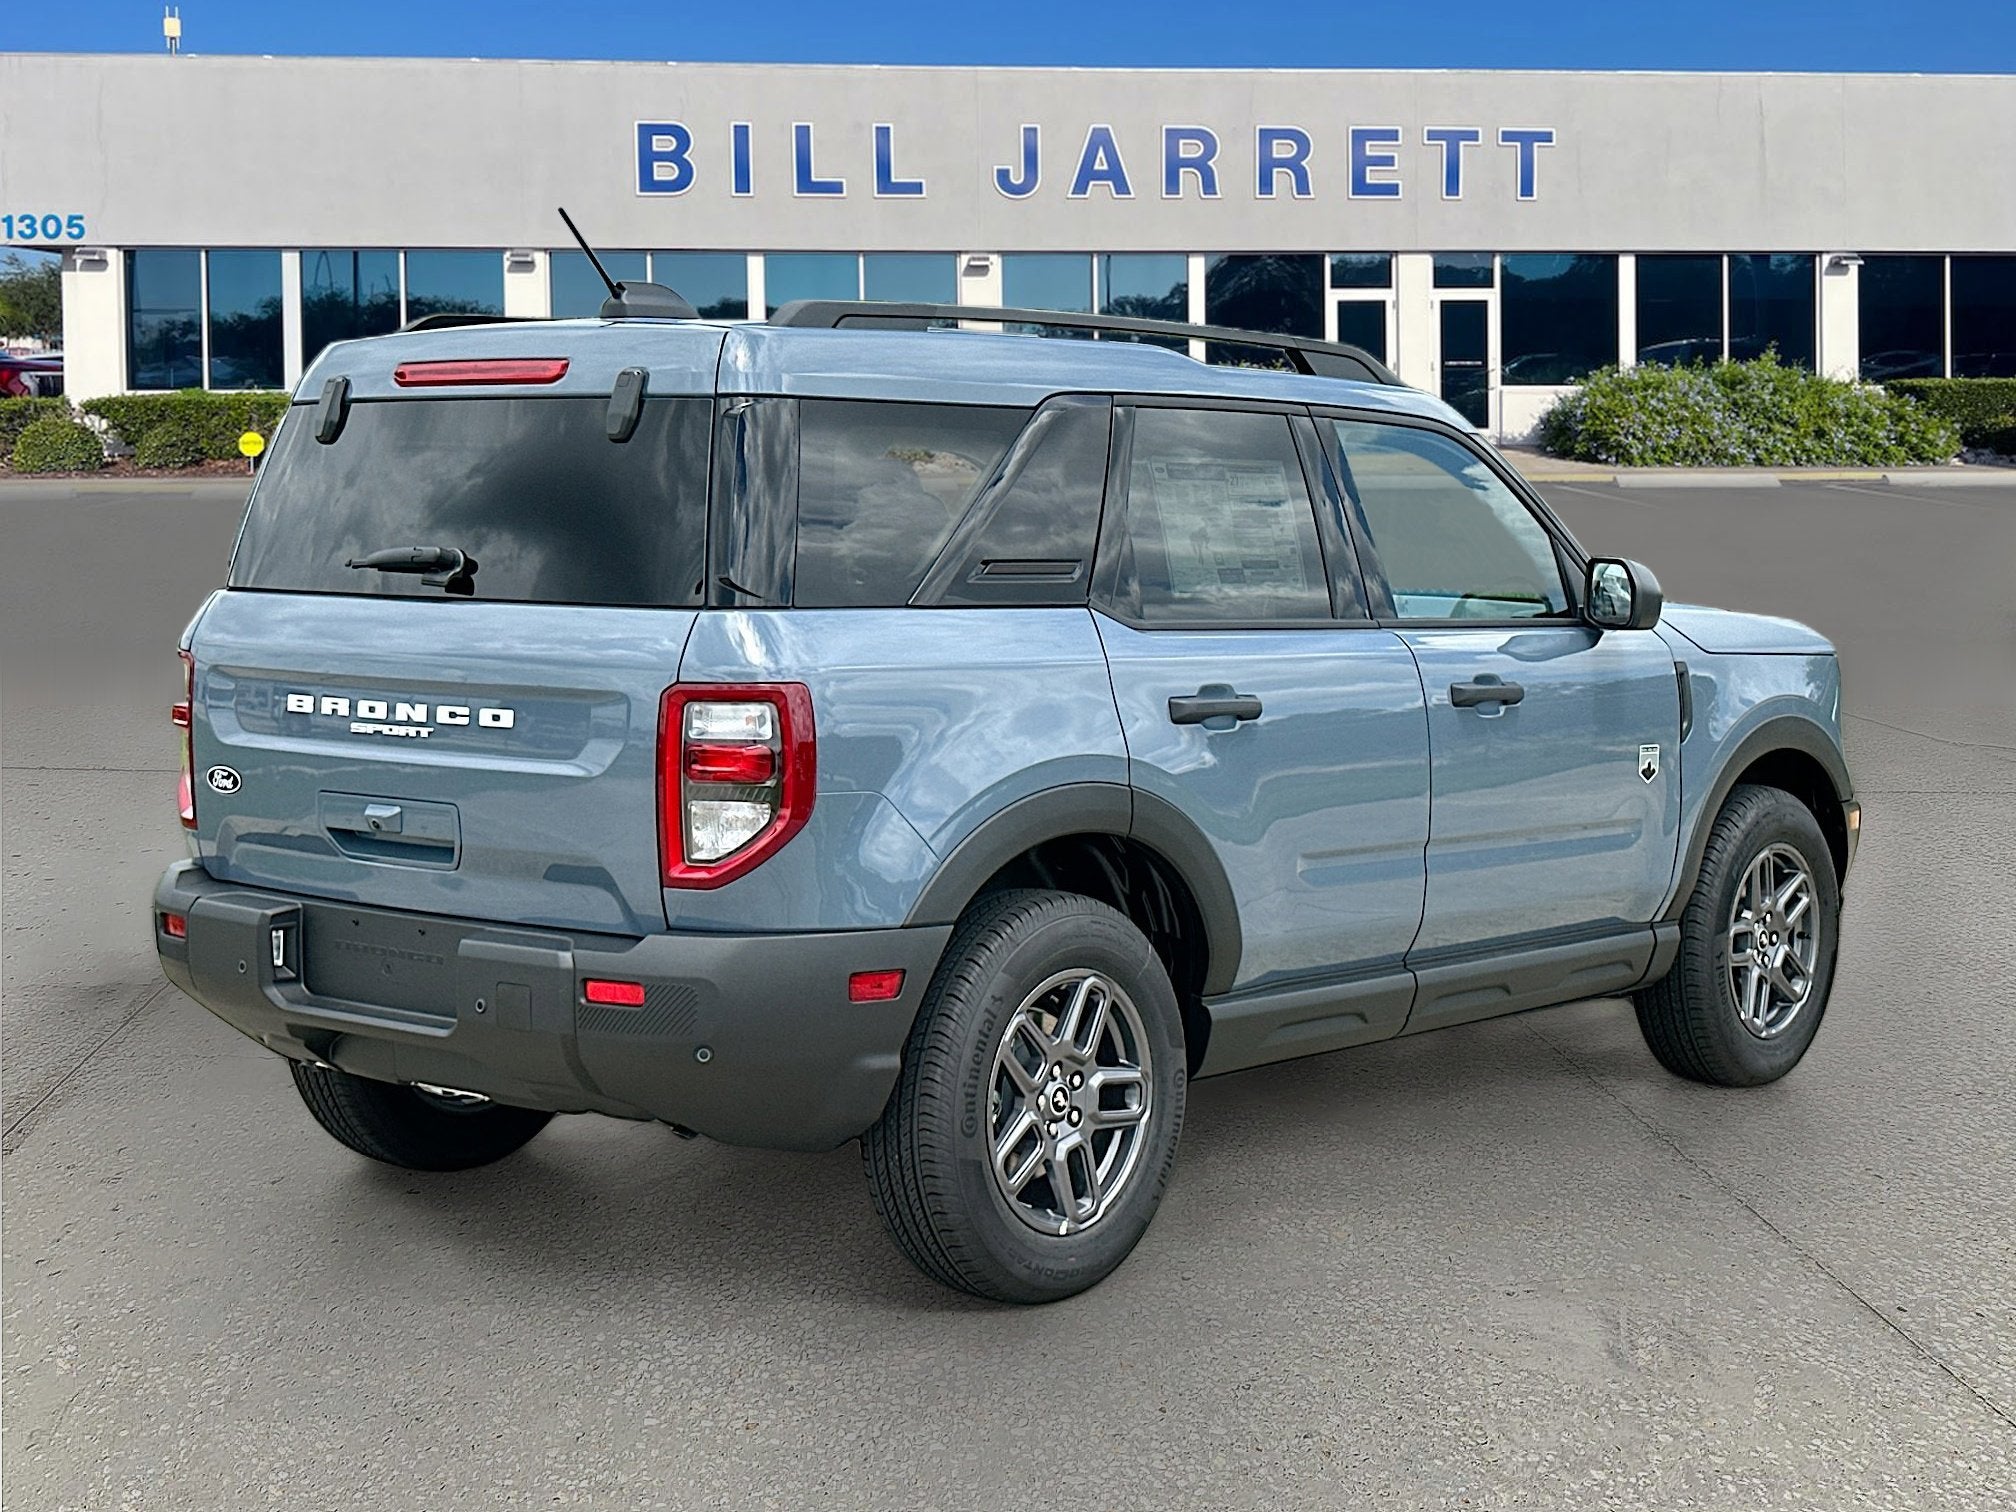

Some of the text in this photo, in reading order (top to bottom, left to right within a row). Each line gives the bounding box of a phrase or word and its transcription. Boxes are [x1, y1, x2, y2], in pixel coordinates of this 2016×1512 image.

[634, 121, 1556, 201] BILL JARRETT
[1, 213, 86, 240] 1305
[286, 693, 515, 729] BRONCO
[349, 722, 434, 738] SPORT
[960, 1007, 998, 1139] Continental
